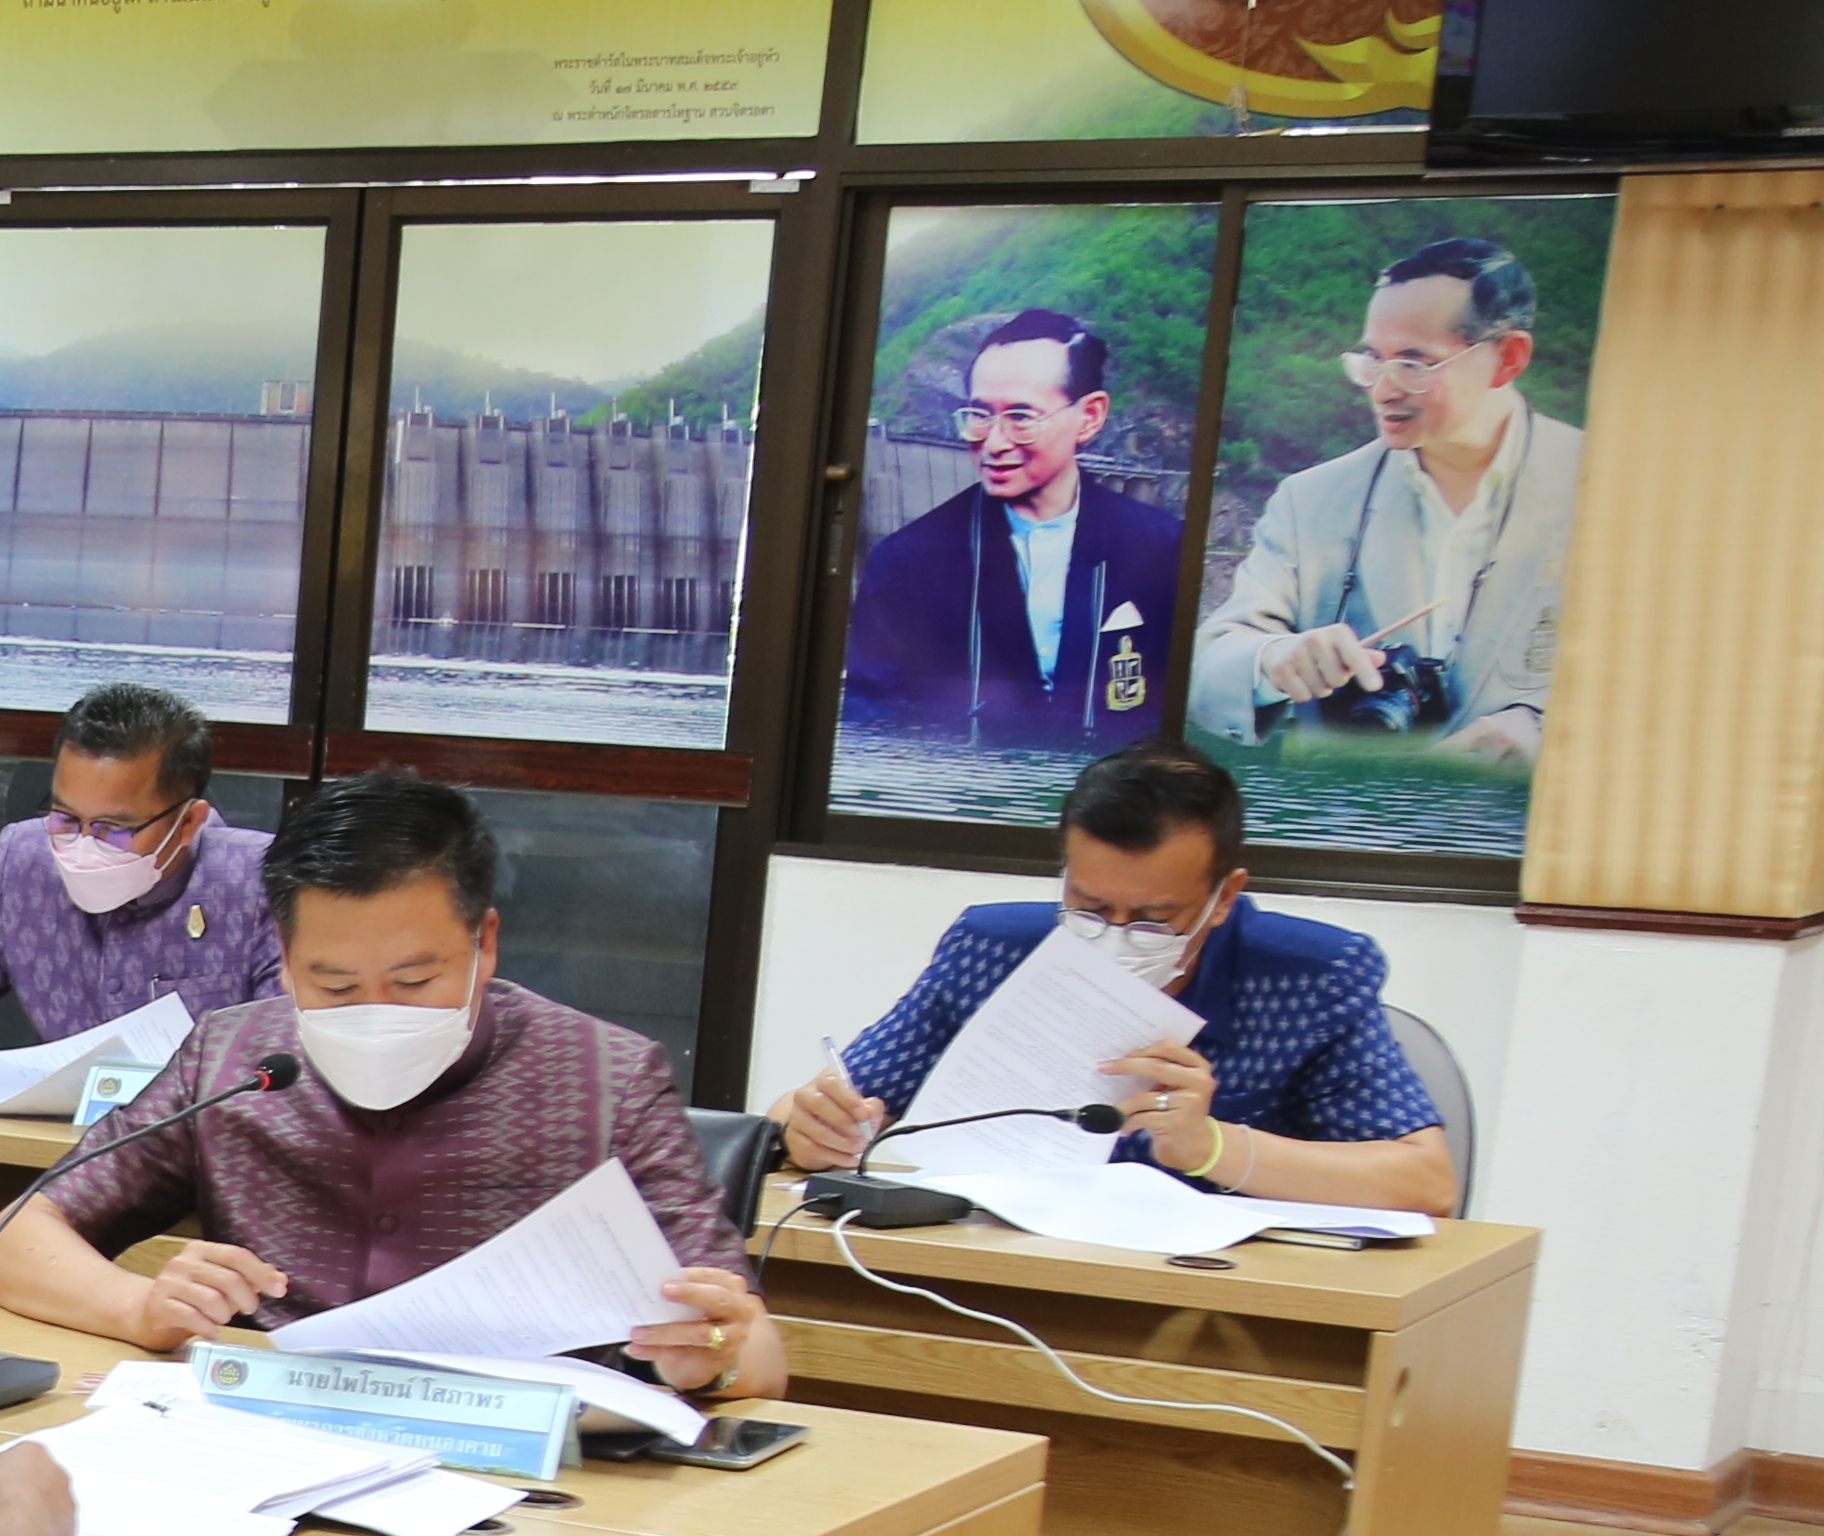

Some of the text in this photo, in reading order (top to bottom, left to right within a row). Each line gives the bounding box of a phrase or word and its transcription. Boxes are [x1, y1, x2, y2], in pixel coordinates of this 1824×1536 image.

[288, 1366, 507, 1409] นายไพโรจน์ โสภาพร
